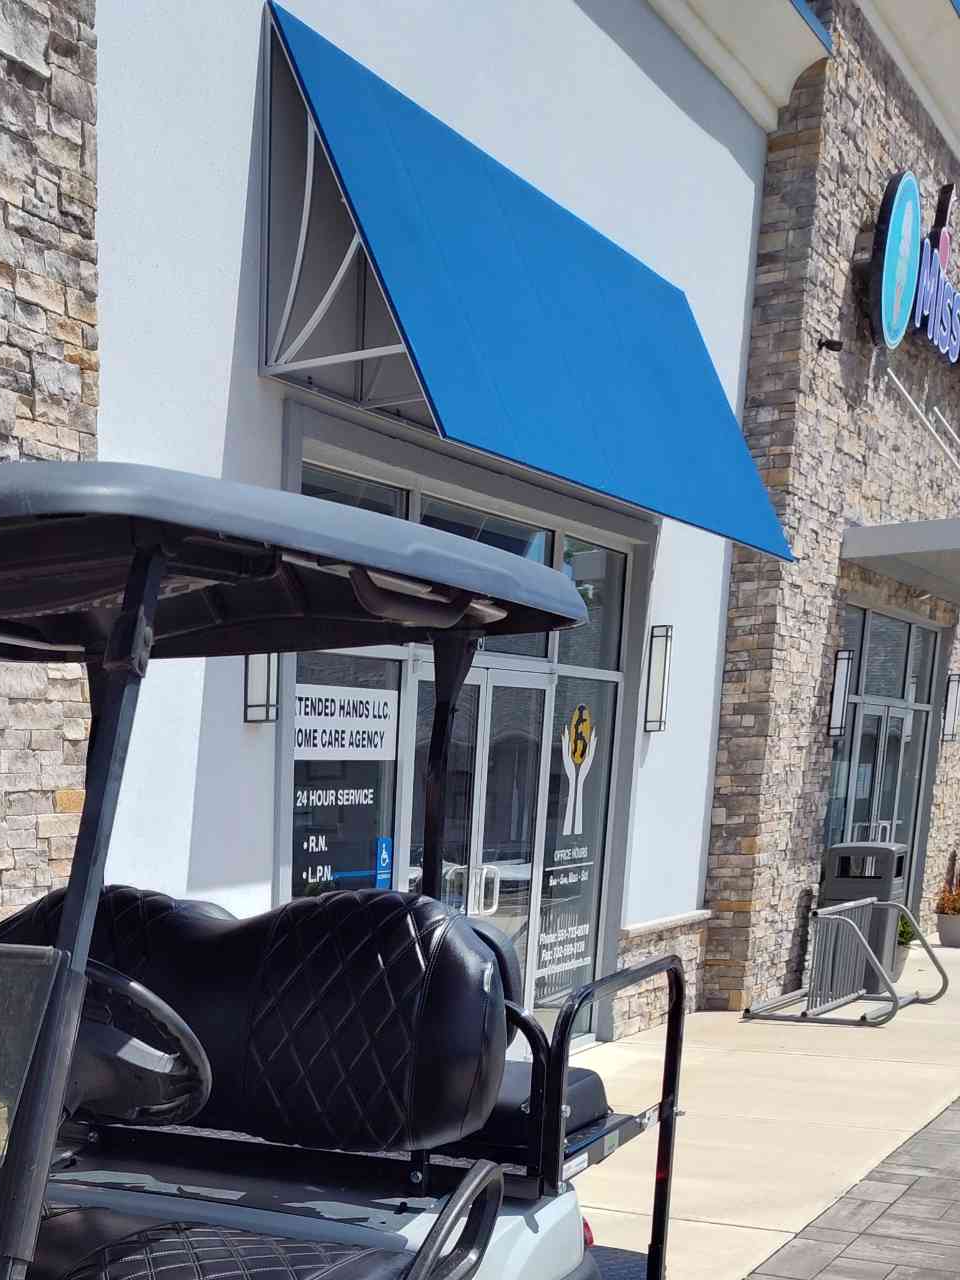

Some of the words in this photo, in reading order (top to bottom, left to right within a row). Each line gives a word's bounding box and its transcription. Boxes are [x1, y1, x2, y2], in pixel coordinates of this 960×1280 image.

[295, 696, 337, 717] TENDED
[339, 698, 370, 719] HANDS
[321, 729, 346, 748] CARE
[348, 730, 385, 749] AGENCY
[296, 791, 307, 806] 24
[309, 790, 336, 806] HOUR
[337, 789, 374, 806] SERVICE
[308, 835, 328, 853] R.N.
